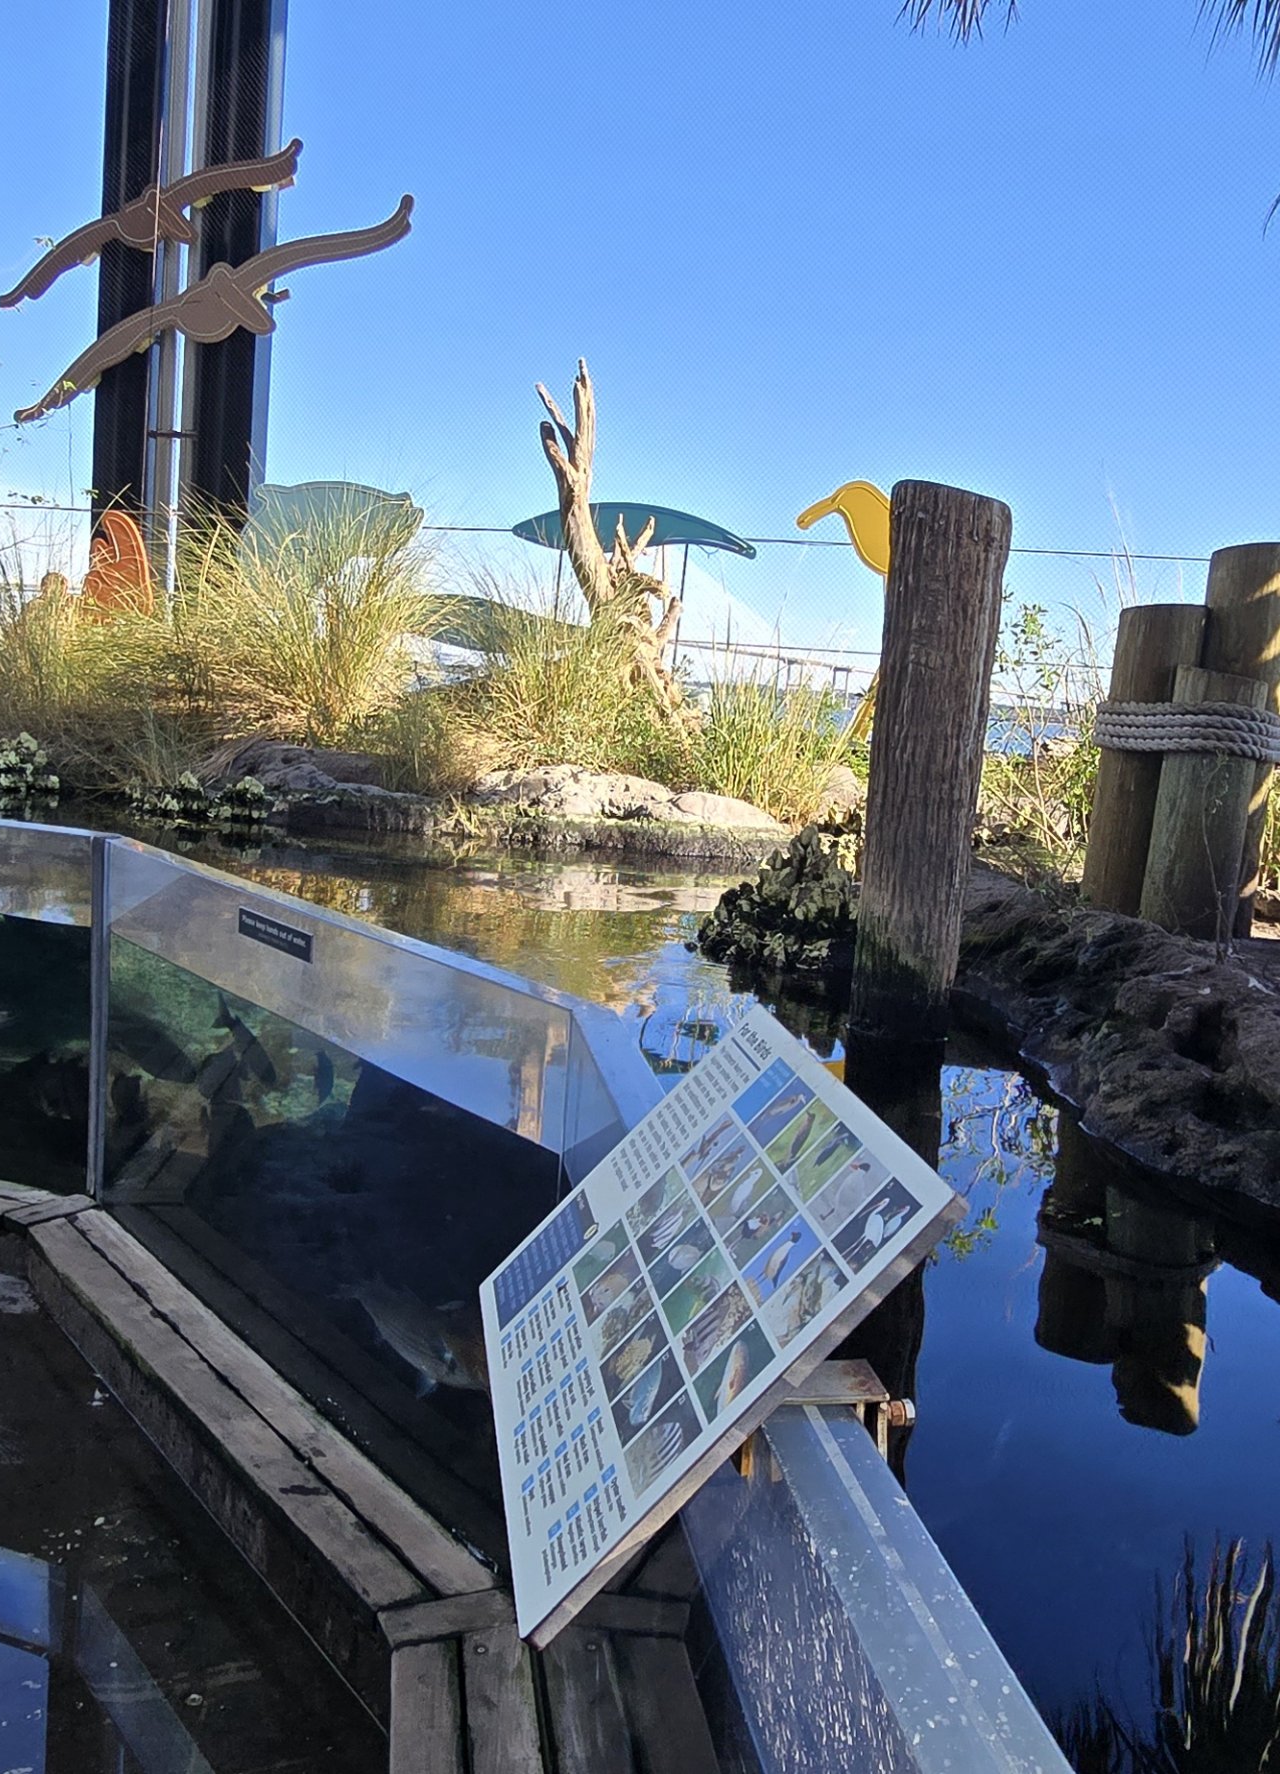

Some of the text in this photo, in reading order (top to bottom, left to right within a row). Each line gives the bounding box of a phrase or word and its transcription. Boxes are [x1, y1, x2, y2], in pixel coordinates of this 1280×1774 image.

[738, 1022, 772, 1060] For the Birds
